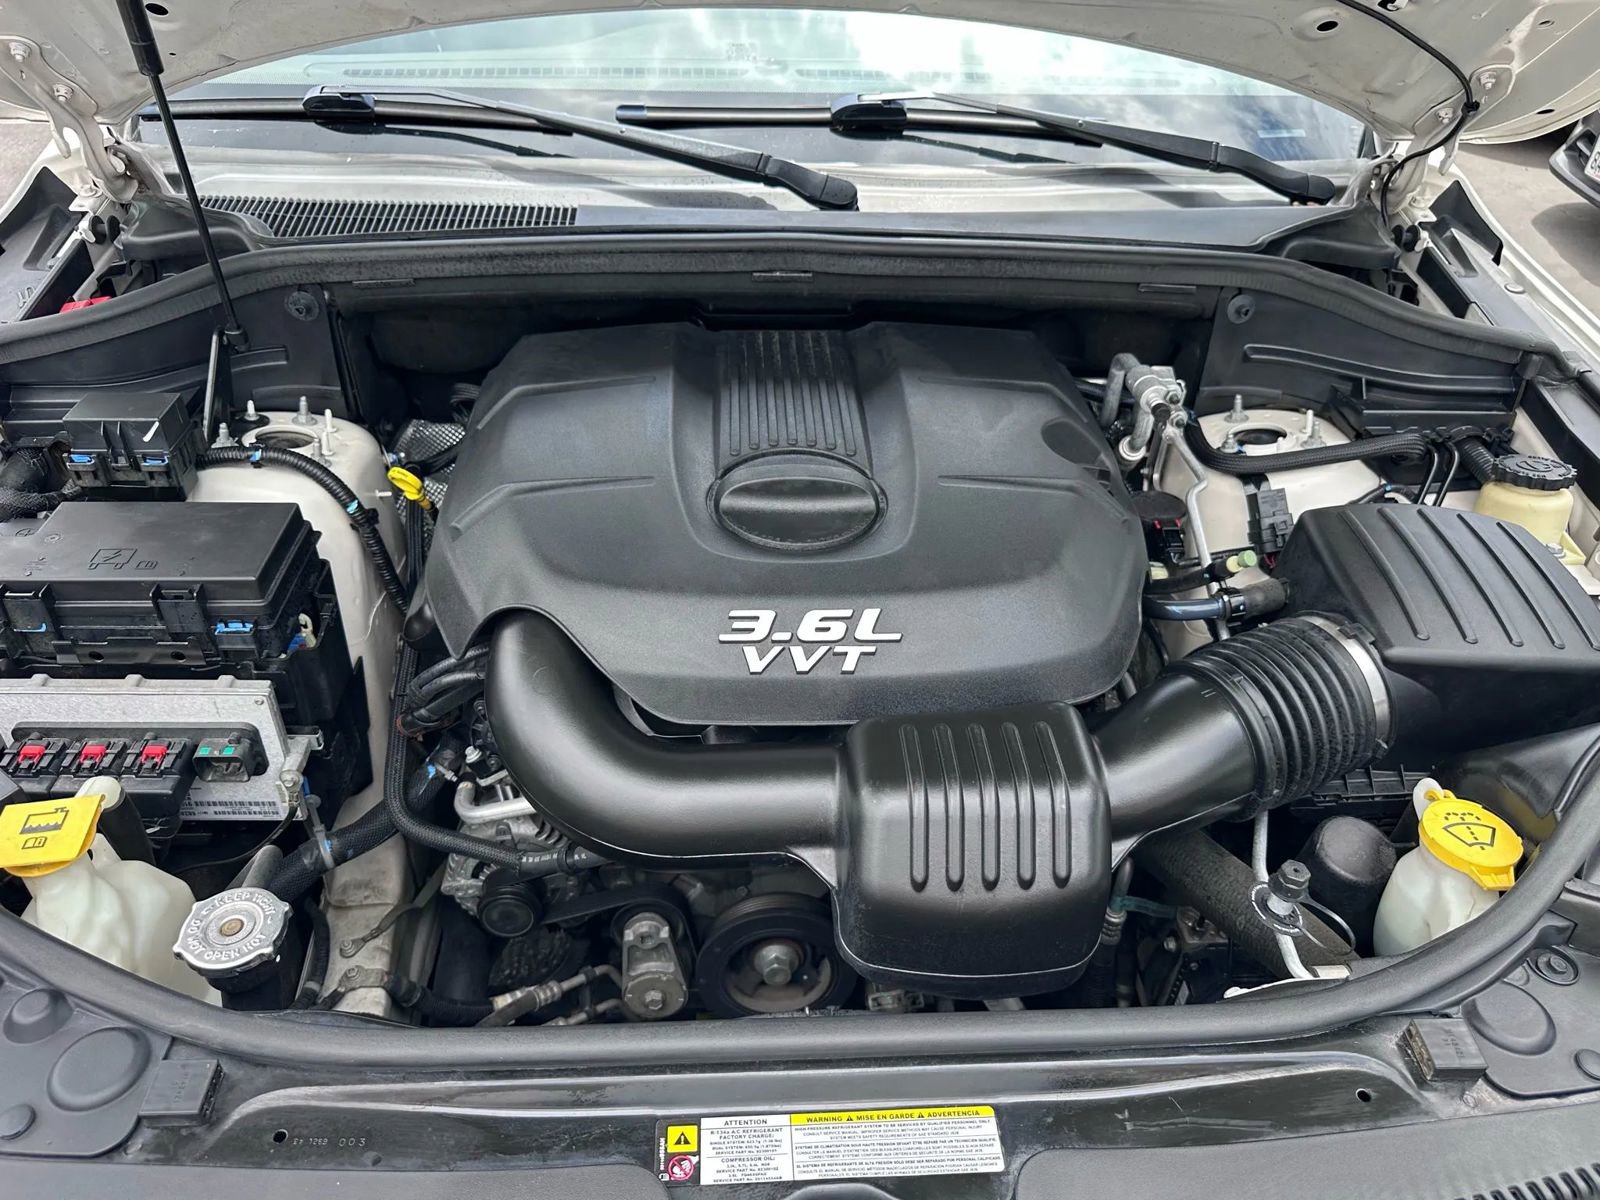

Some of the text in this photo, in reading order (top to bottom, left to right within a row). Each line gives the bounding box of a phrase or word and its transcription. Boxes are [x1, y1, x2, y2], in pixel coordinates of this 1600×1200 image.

[718, 608, 903, 643] 3.6L
[742, 645, 877, 675] VVT
[214, 891, 250, 906] KEEP
[187, 937, 206, 953] NOT
[204, 948, 241, 960] OPEN
[927, 1110, 980, 1118] ADVERTENCIA
